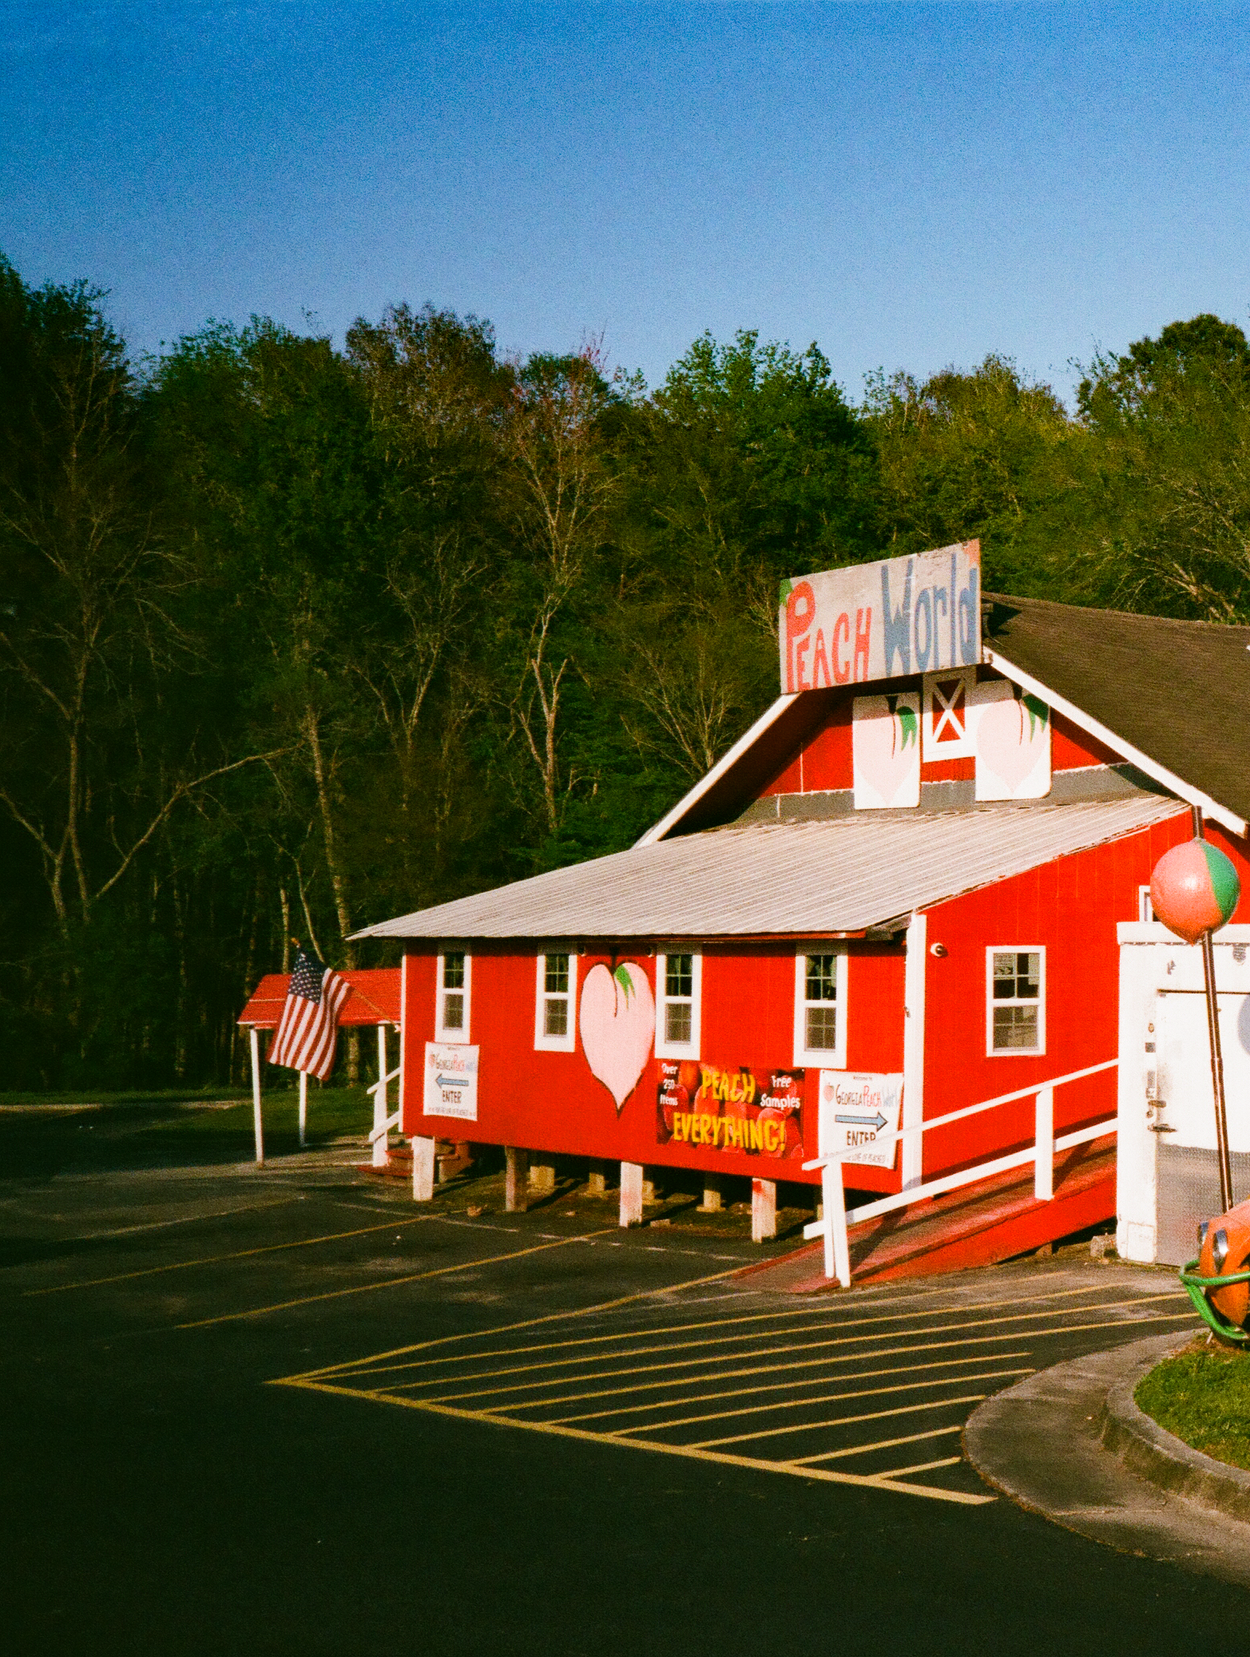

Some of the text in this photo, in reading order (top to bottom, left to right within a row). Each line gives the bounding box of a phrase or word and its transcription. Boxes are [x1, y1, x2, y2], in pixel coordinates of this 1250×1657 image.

[785, 552, 978, 692] PEACH World
[661, 1063, 678, 1075] Over
[663, 1078, 675, 1090] 250
[701, 1069, 756, 1103] PEACH
[771, 1075, 792, 1088] Free
[442, 1090, 462, 1104] ENTER
[660, 1094, 678, 1106] Items
[760, 1093, 800, 1110] Samples
[673, 1112, 786, 1152] EVERYTHING!
